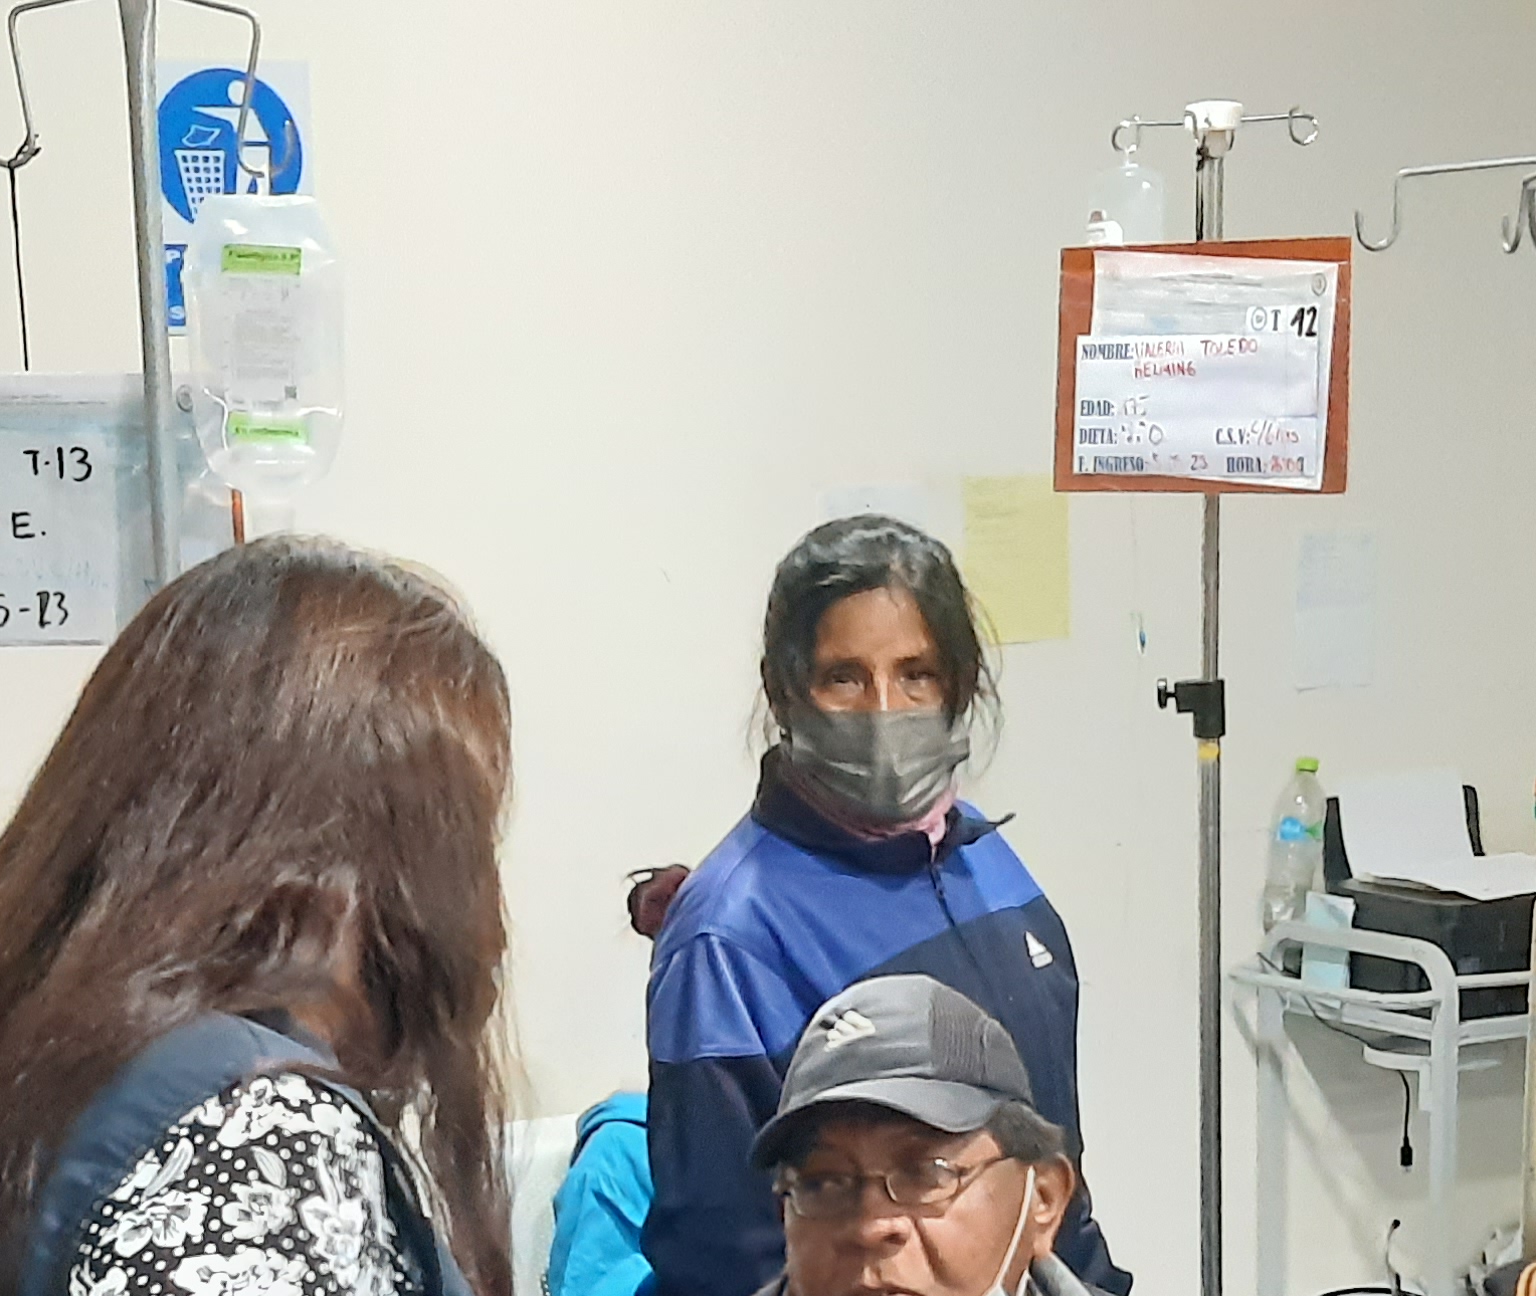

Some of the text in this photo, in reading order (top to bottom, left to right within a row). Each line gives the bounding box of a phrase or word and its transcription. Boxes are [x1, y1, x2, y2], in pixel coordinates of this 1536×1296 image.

[1290, 306, 1318, 337] 12
[1080, 399, 1115, 417] EDAD:
[1079, 427, 1118, 445] DIETA:
[11, 511, 47, 539] E.
